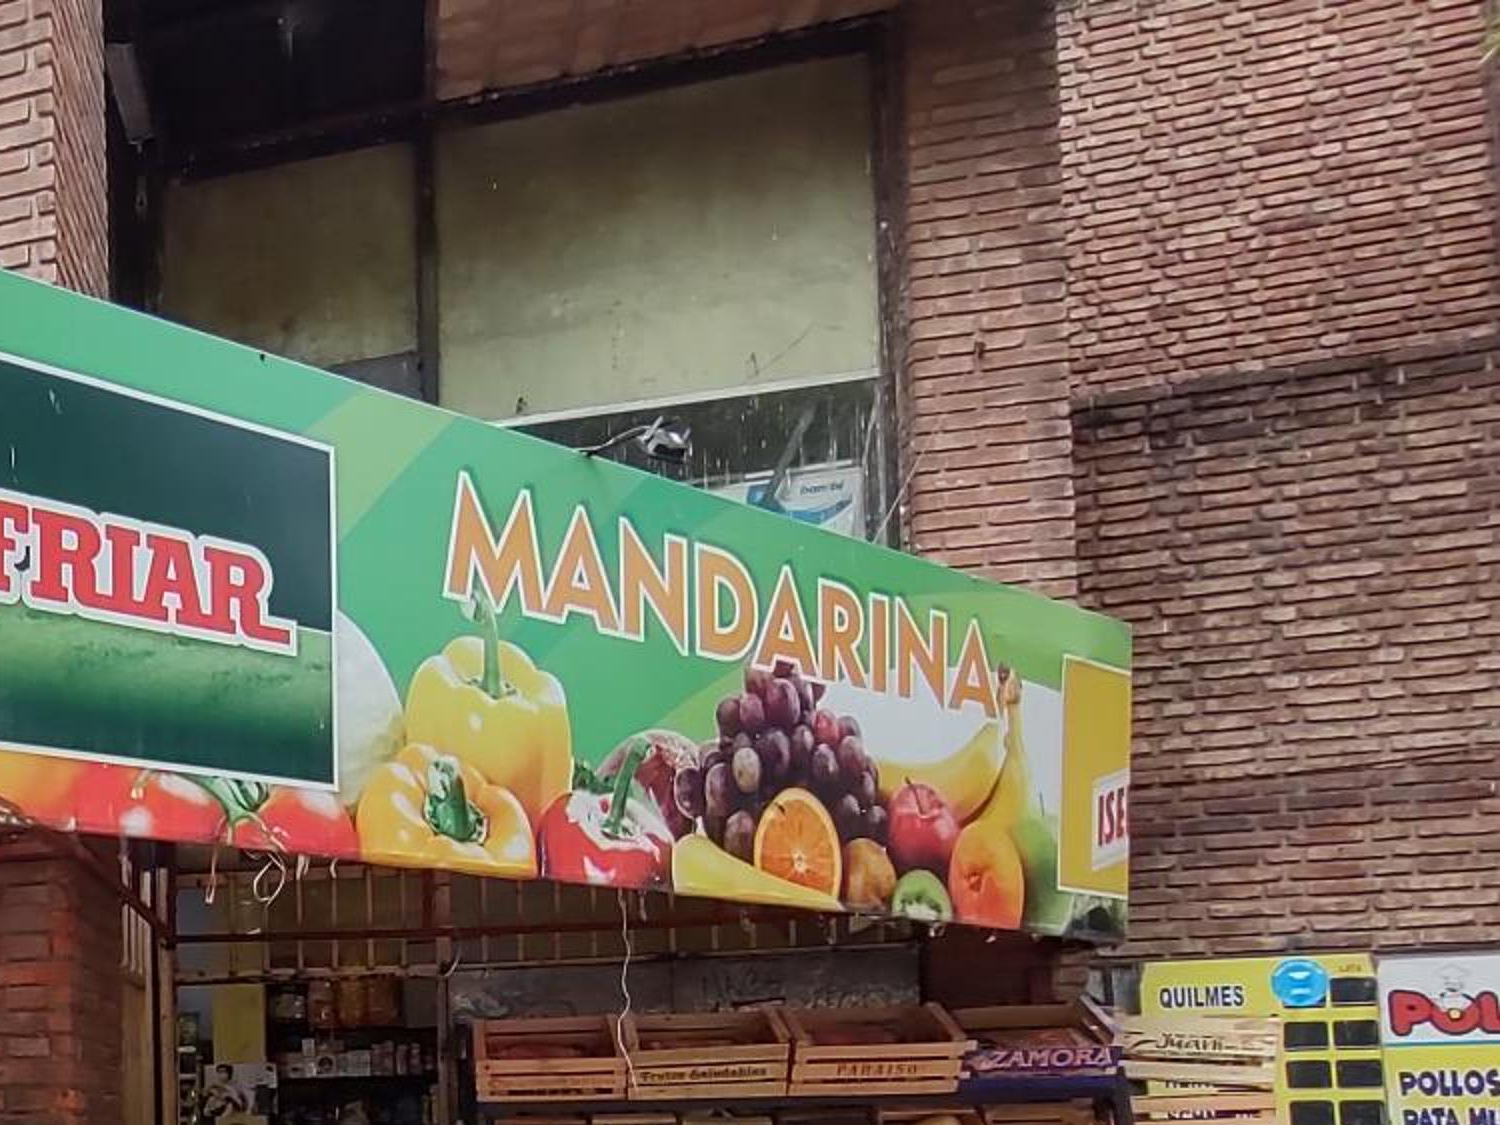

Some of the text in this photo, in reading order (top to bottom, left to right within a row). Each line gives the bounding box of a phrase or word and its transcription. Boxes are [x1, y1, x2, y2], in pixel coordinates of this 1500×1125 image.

[442, 470, 1000, 720] MANDARINA
[1159, 985, 1245, 1009] QUILMES
[984, 1047, 1113, 1069] ZAMORA
